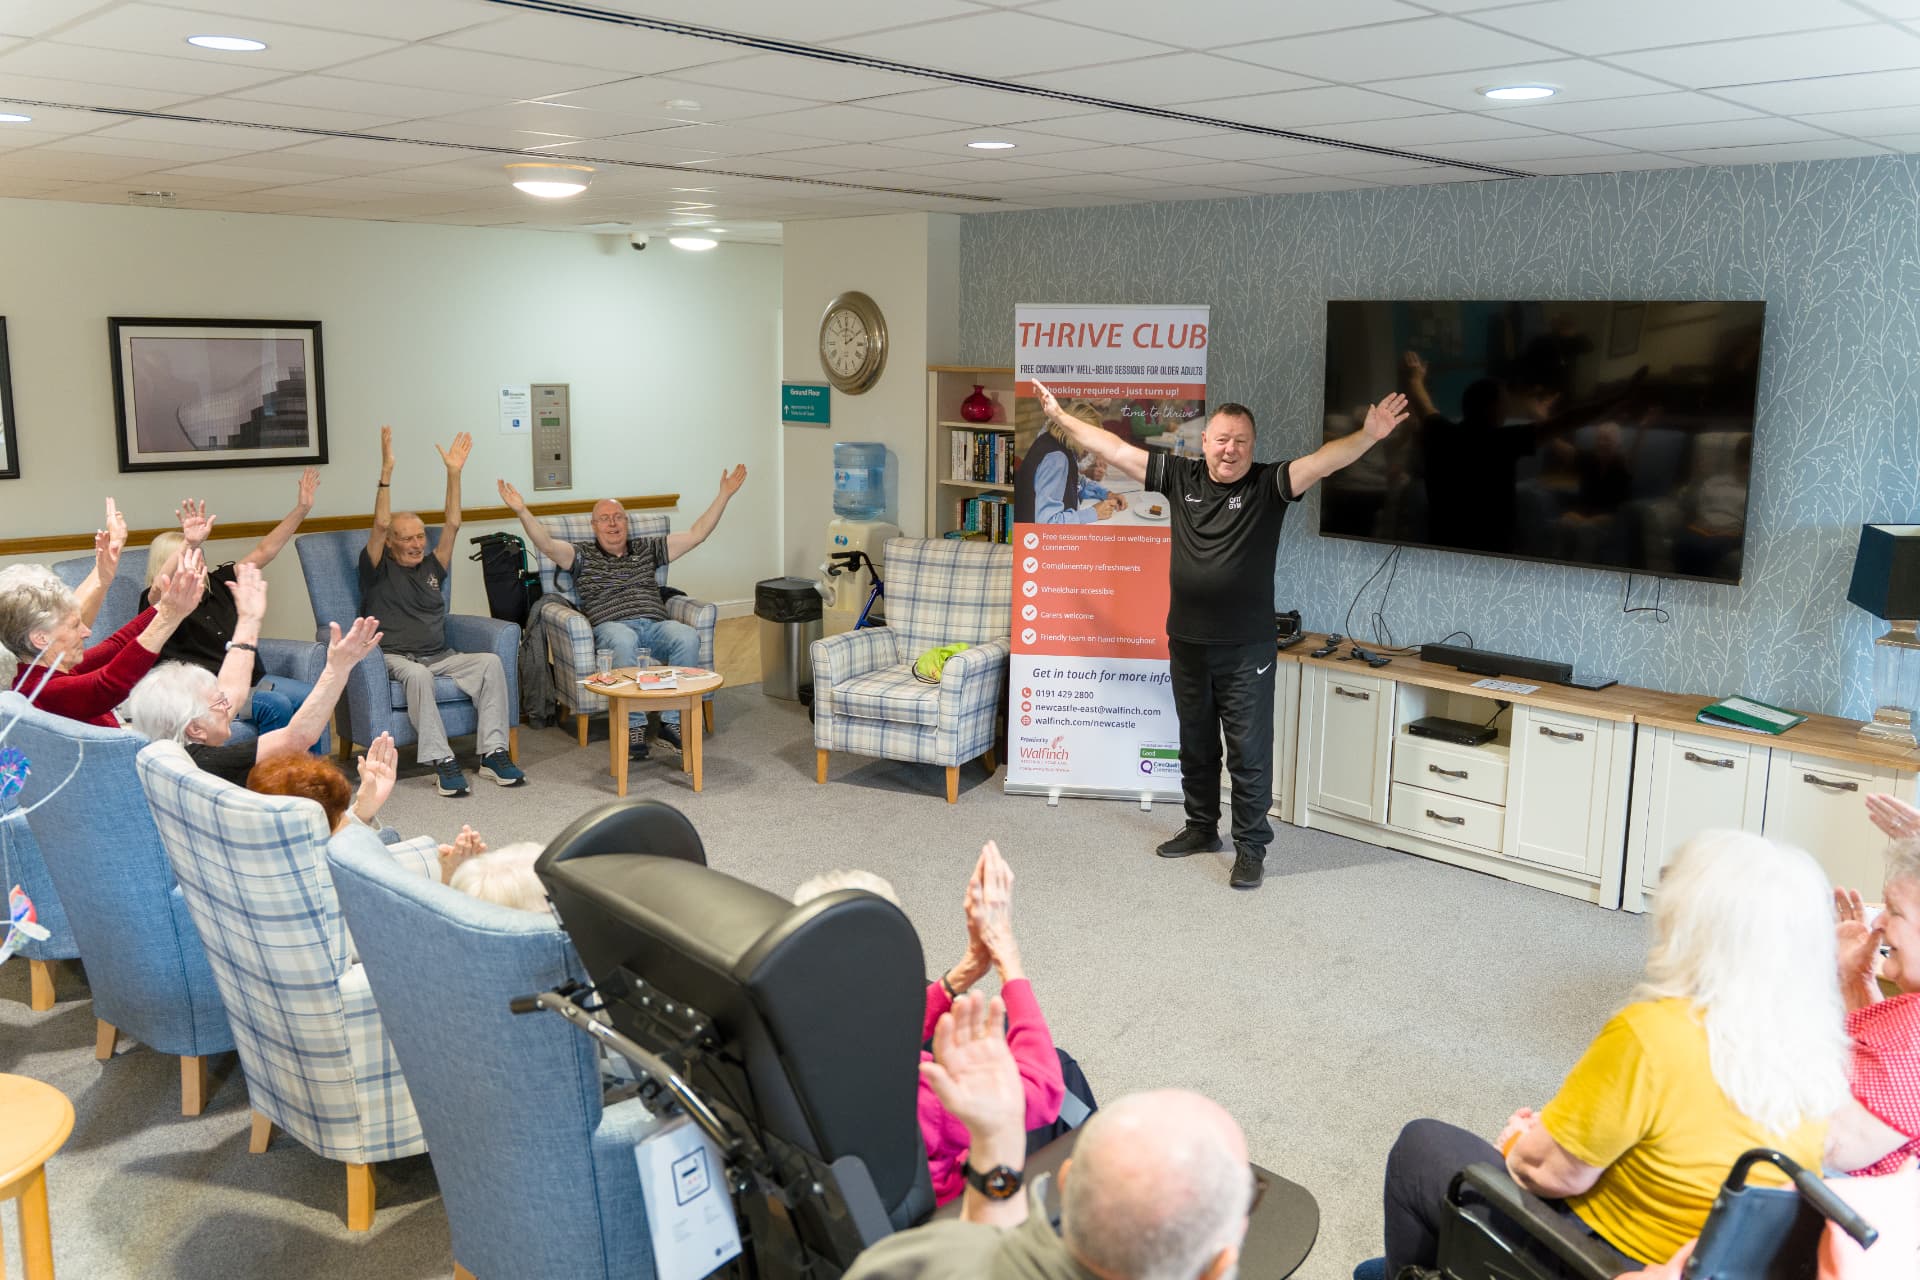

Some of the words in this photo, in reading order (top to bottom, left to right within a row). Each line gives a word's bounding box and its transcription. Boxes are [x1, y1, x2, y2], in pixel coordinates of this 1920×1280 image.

[1018, 322, 1125, 348] THRIVE
[1132, 323, 1208, 349] CLUB
[1020, 364, 1034, 374] FREE
[1035, 364, 1075, 374] COMMUNITY
[1076, 365, 1114, 375] WELL-BEING
[1114, 365, 1145, 375] SESSIONS
[1146, 366, 1159, 376] FOR
[1160, 366, 1180, 376] OLDER
[1181, 366, 1203, 376] ADULTS
[1083, 386, 1120, 397] required
[1126, 386, 1143, 397] just
[1144, 387, 1163, 396] turn
[1165, 387, 1180, 397] up!
[1042, 533, 1057, 541] Free
[1089, 533, 1116, 542] focused
[1127, 535, 1161, 544] wellbeing
[1041, 562, 1093, 572] Complimentary
[1095, 564, 1141, 572] refreshments
[1041, 586, 1079, 595] Wheelchair
[1040, 611, 1062, 619] Carers
[1063, 612, 1095, 620] welcome
[1040, 634, 1067, 643] Friendly
[1097, 635, 1116, 643] hand
[1032, 668, 1052, 678] Get
[1053, 668, 1064, 679] in
[1066, 669, 1097, 680] touch
[1098, 670, 1116, 683] for
[1118, 673, 1147, 682] more
[1149, 672, 1171, 686] info
[1035, 690, 1055, 698] 0191
[1057, 690, 1072, 699] 429
[1074, 691, 1094, 699] 2800
[1035, 704, 1161, 716] newcastle-east@walfinch.com
[1035, 716, 1136, 728] walfinch.com/newcastle
[1020, 746, 1069, 760] Walfinch
